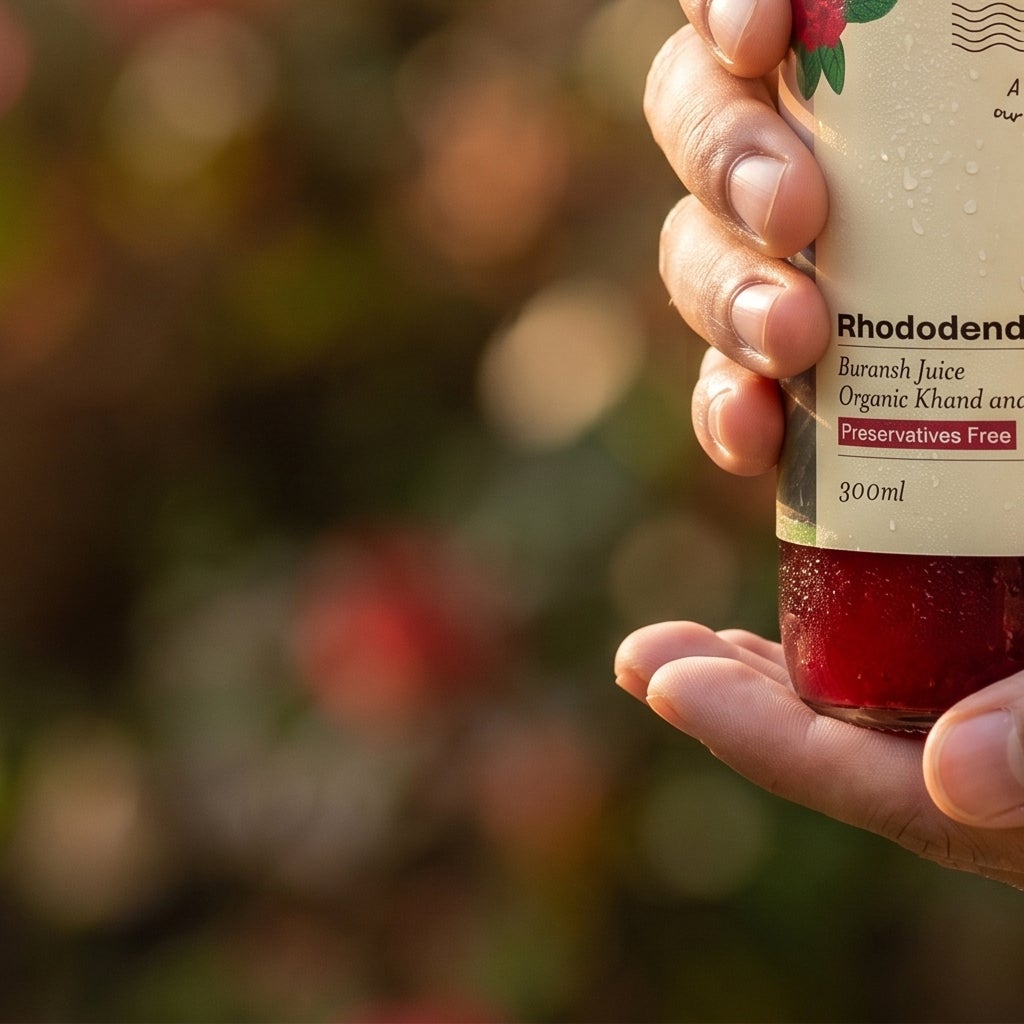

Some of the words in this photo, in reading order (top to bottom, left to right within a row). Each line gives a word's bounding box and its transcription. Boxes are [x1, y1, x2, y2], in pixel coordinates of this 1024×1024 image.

[1006, 78, 1020, 97] A
[993, 108, 1023, 123] our
[838, 355, 911, 380] Buransh
[912, 358, 966, 385] Juice
[838, 384, 909, 414] Organic
[914, 386, 984, 410] Khand
[841, 423, 962, 445] Preservatives
[967, 426, 1012, 445] Free
[838, 479, 906, 503] 300ml
